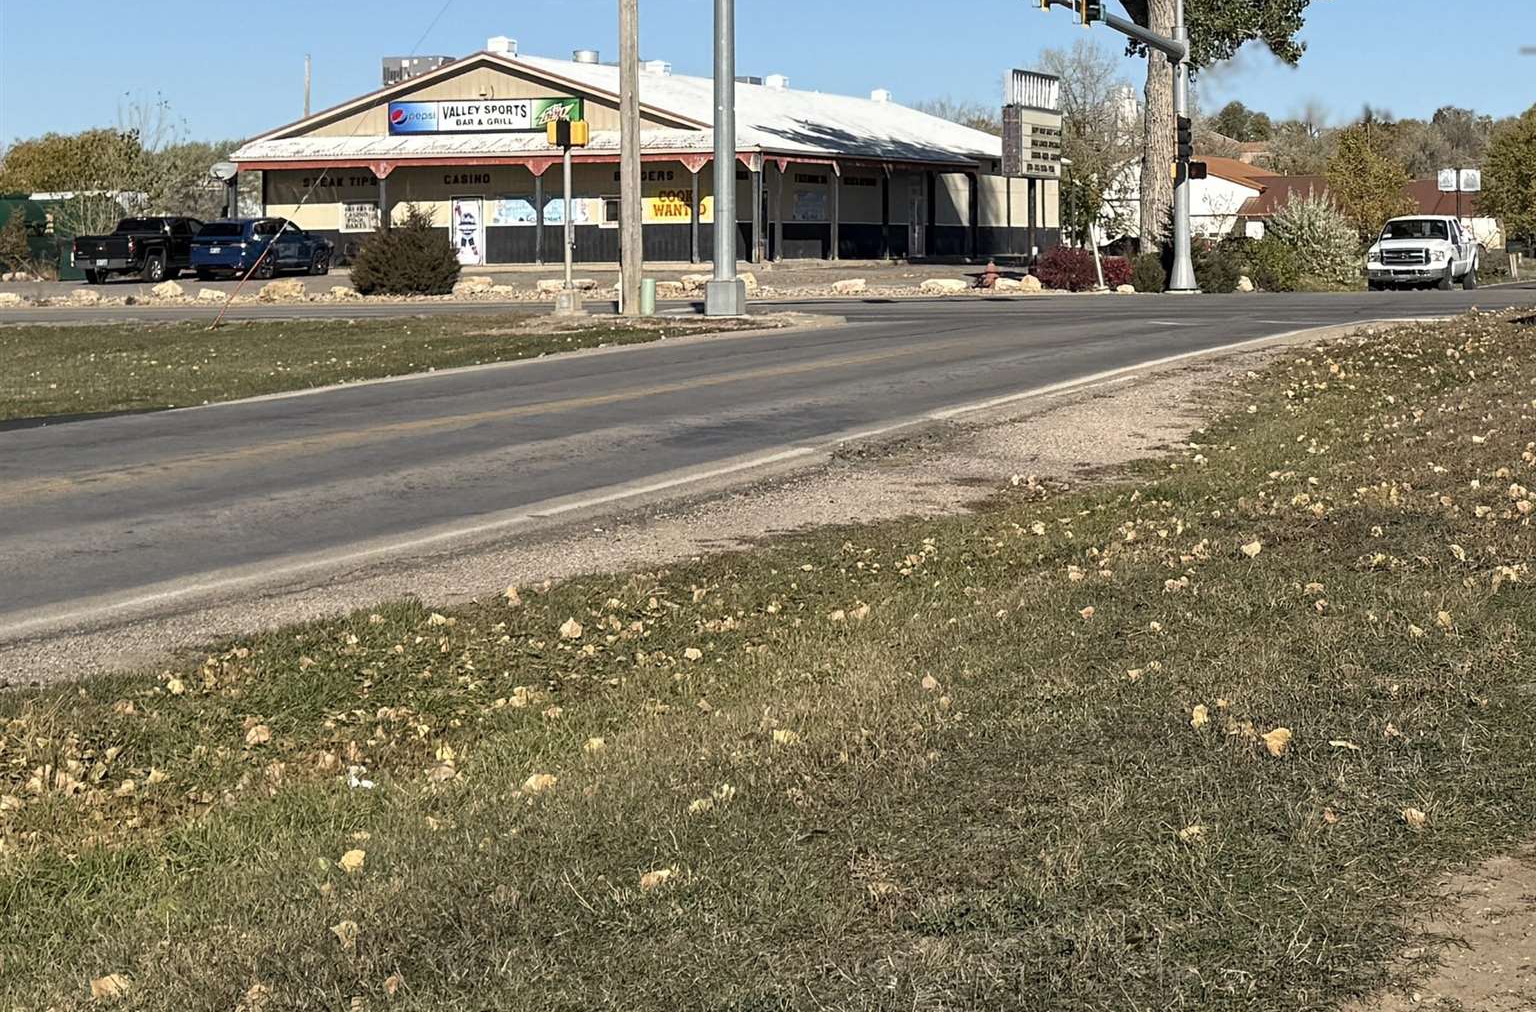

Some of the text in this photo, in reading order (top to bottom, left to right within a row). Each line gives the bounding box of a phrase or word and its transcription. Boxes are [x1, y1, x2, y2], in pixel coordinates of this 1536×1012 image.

[408, 110, 436, 122] pepsi
[442, 105, 480, 120] VALLEY
[484, 103, 527, 118] SPORTS
[455, 117, 513, 126] BAR & GRILL
[349, 175, 377, 187] TIPS
[444, 173, 491, 185] CASINO
[658, 189, 693, 203] COOK
[653, 203, 707, 217] WANTD
